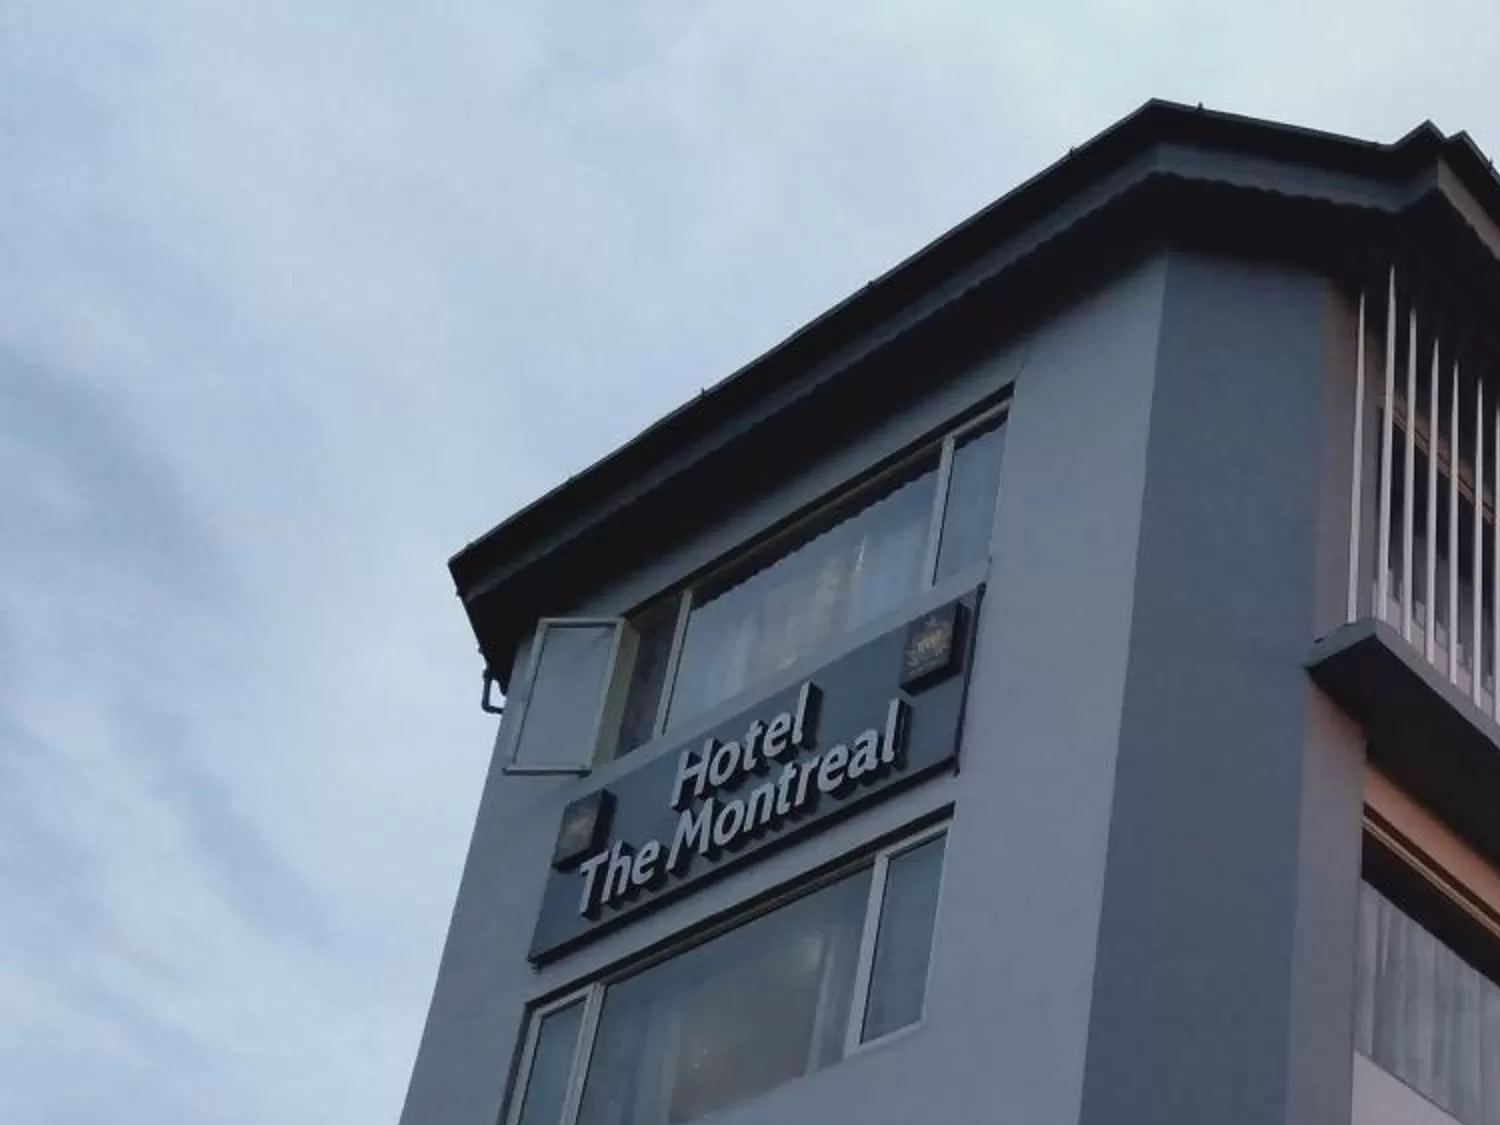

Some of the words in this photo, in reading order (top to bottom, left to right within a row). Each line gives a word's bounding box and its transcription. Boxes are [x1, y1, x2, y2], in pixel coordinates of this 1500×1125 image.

[579, 839, 659, 912] The
[667, 698, 902, 870] Montreal
[670, 681, 814, 808] Hotel
